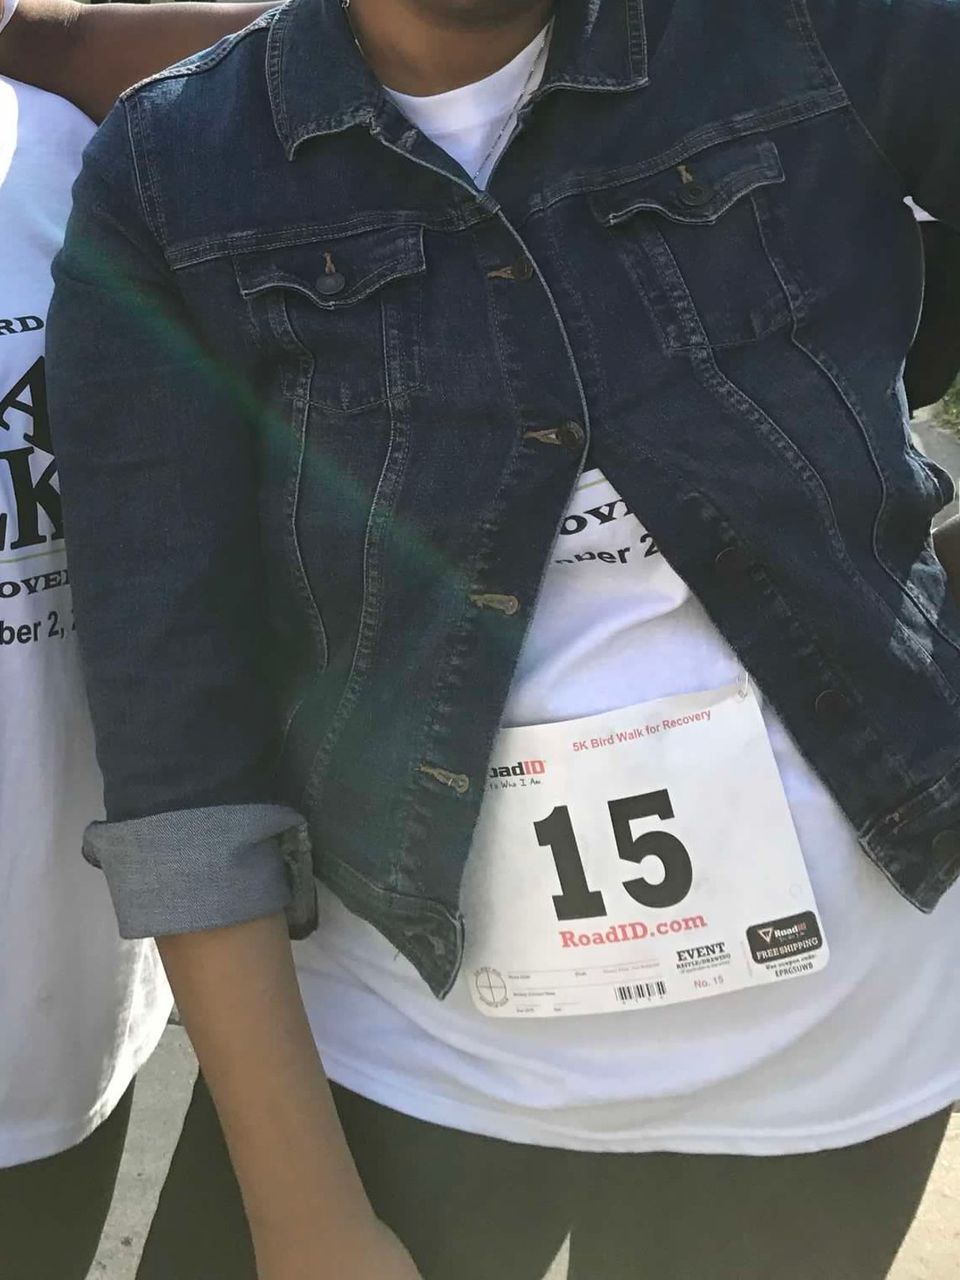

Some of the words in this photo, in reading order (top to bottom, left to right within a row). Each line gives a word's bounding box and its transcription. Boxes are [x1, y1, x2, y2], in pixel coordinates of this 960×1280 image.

[48, 611, 66, 640] 2,
[572, 741, 589, 752] 5K
[591, 734, 615, 749] Bird
[615, 726, 644, 743] Walk
[645, 723, 661, 735] for
[662, 708, 712, 730] Recovery
[534, 788, 693, 921] 15
[558, 912, 708, 948] RoadID.com
[676, 942, 726, 962] EVENT
[756, 947, 780, 960] FREE
